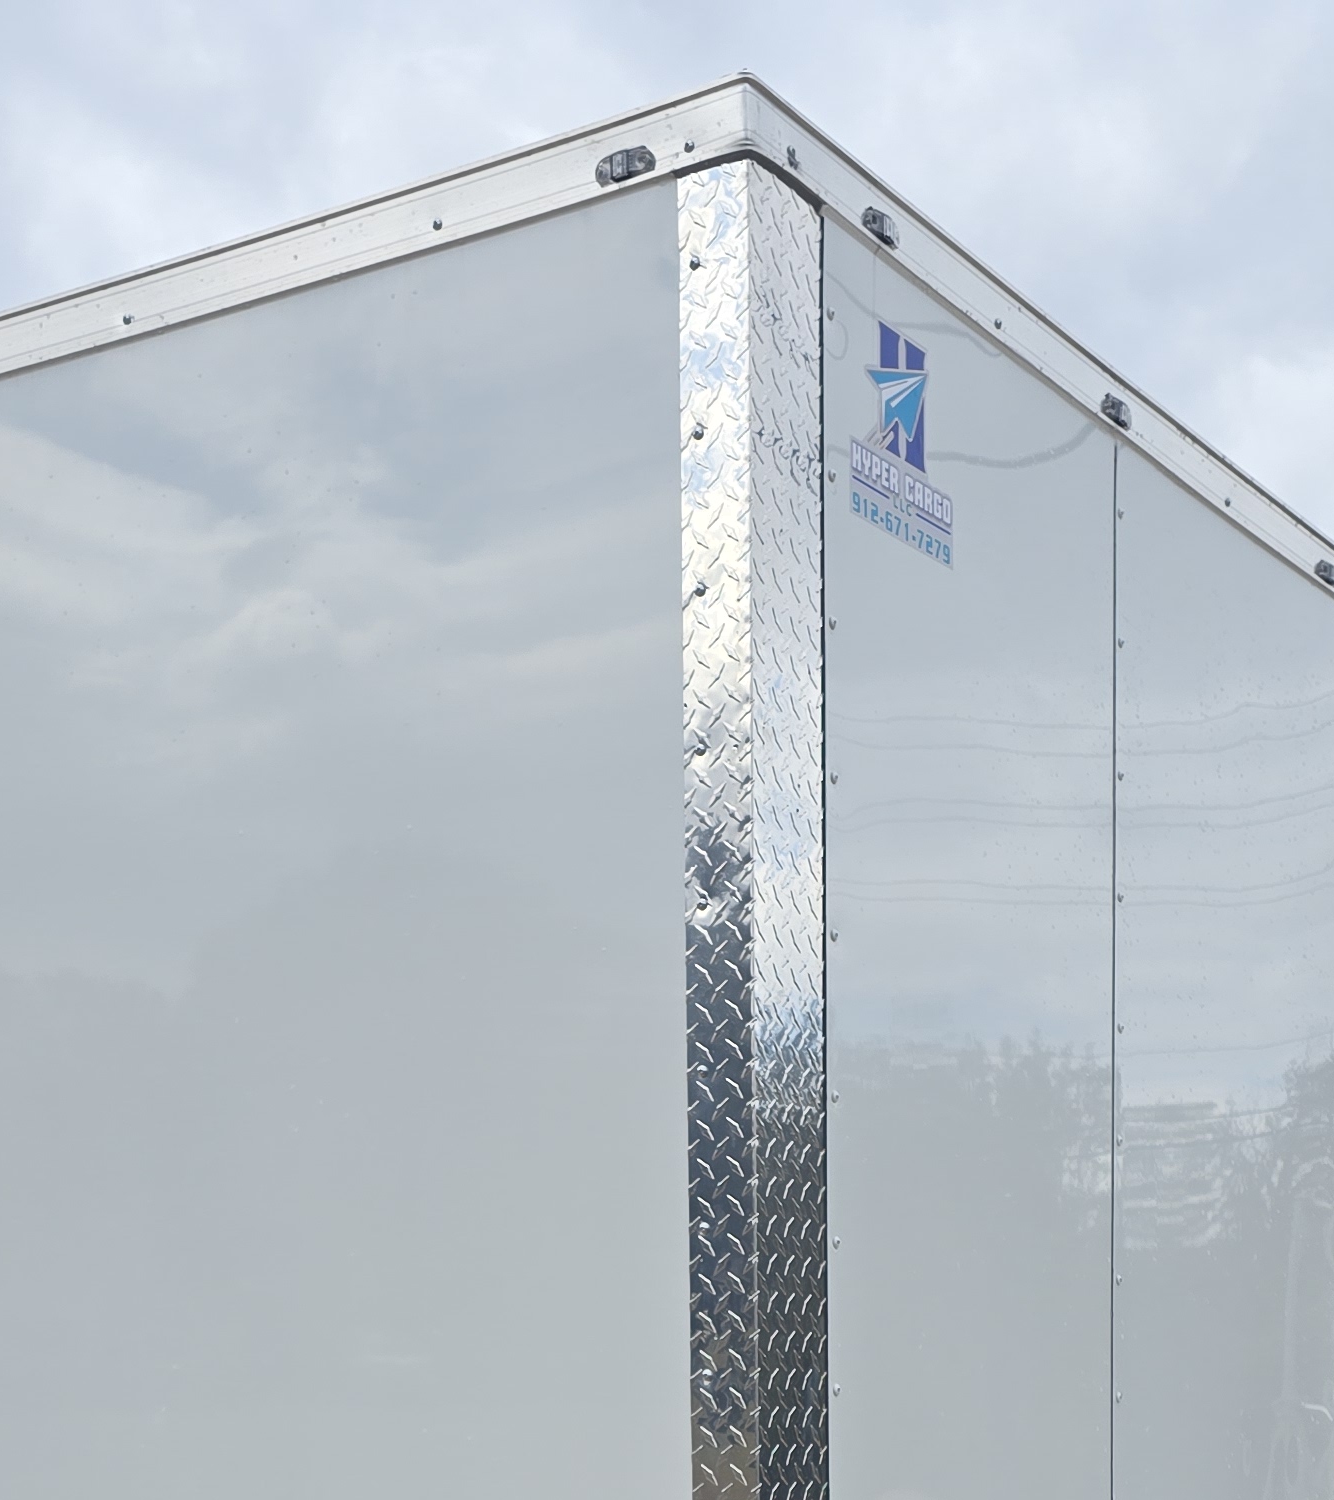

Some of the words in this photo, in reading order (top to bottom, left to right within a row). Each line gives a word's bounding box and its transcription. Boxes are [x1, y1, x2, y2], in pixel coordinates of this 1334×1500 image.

[851, 441, 899, 495] HYPER
[904, 474, 952, 525] CARGO
[892, 493, 913, 517] LLC
[852, 491, 951, 565] 912-671-7279
